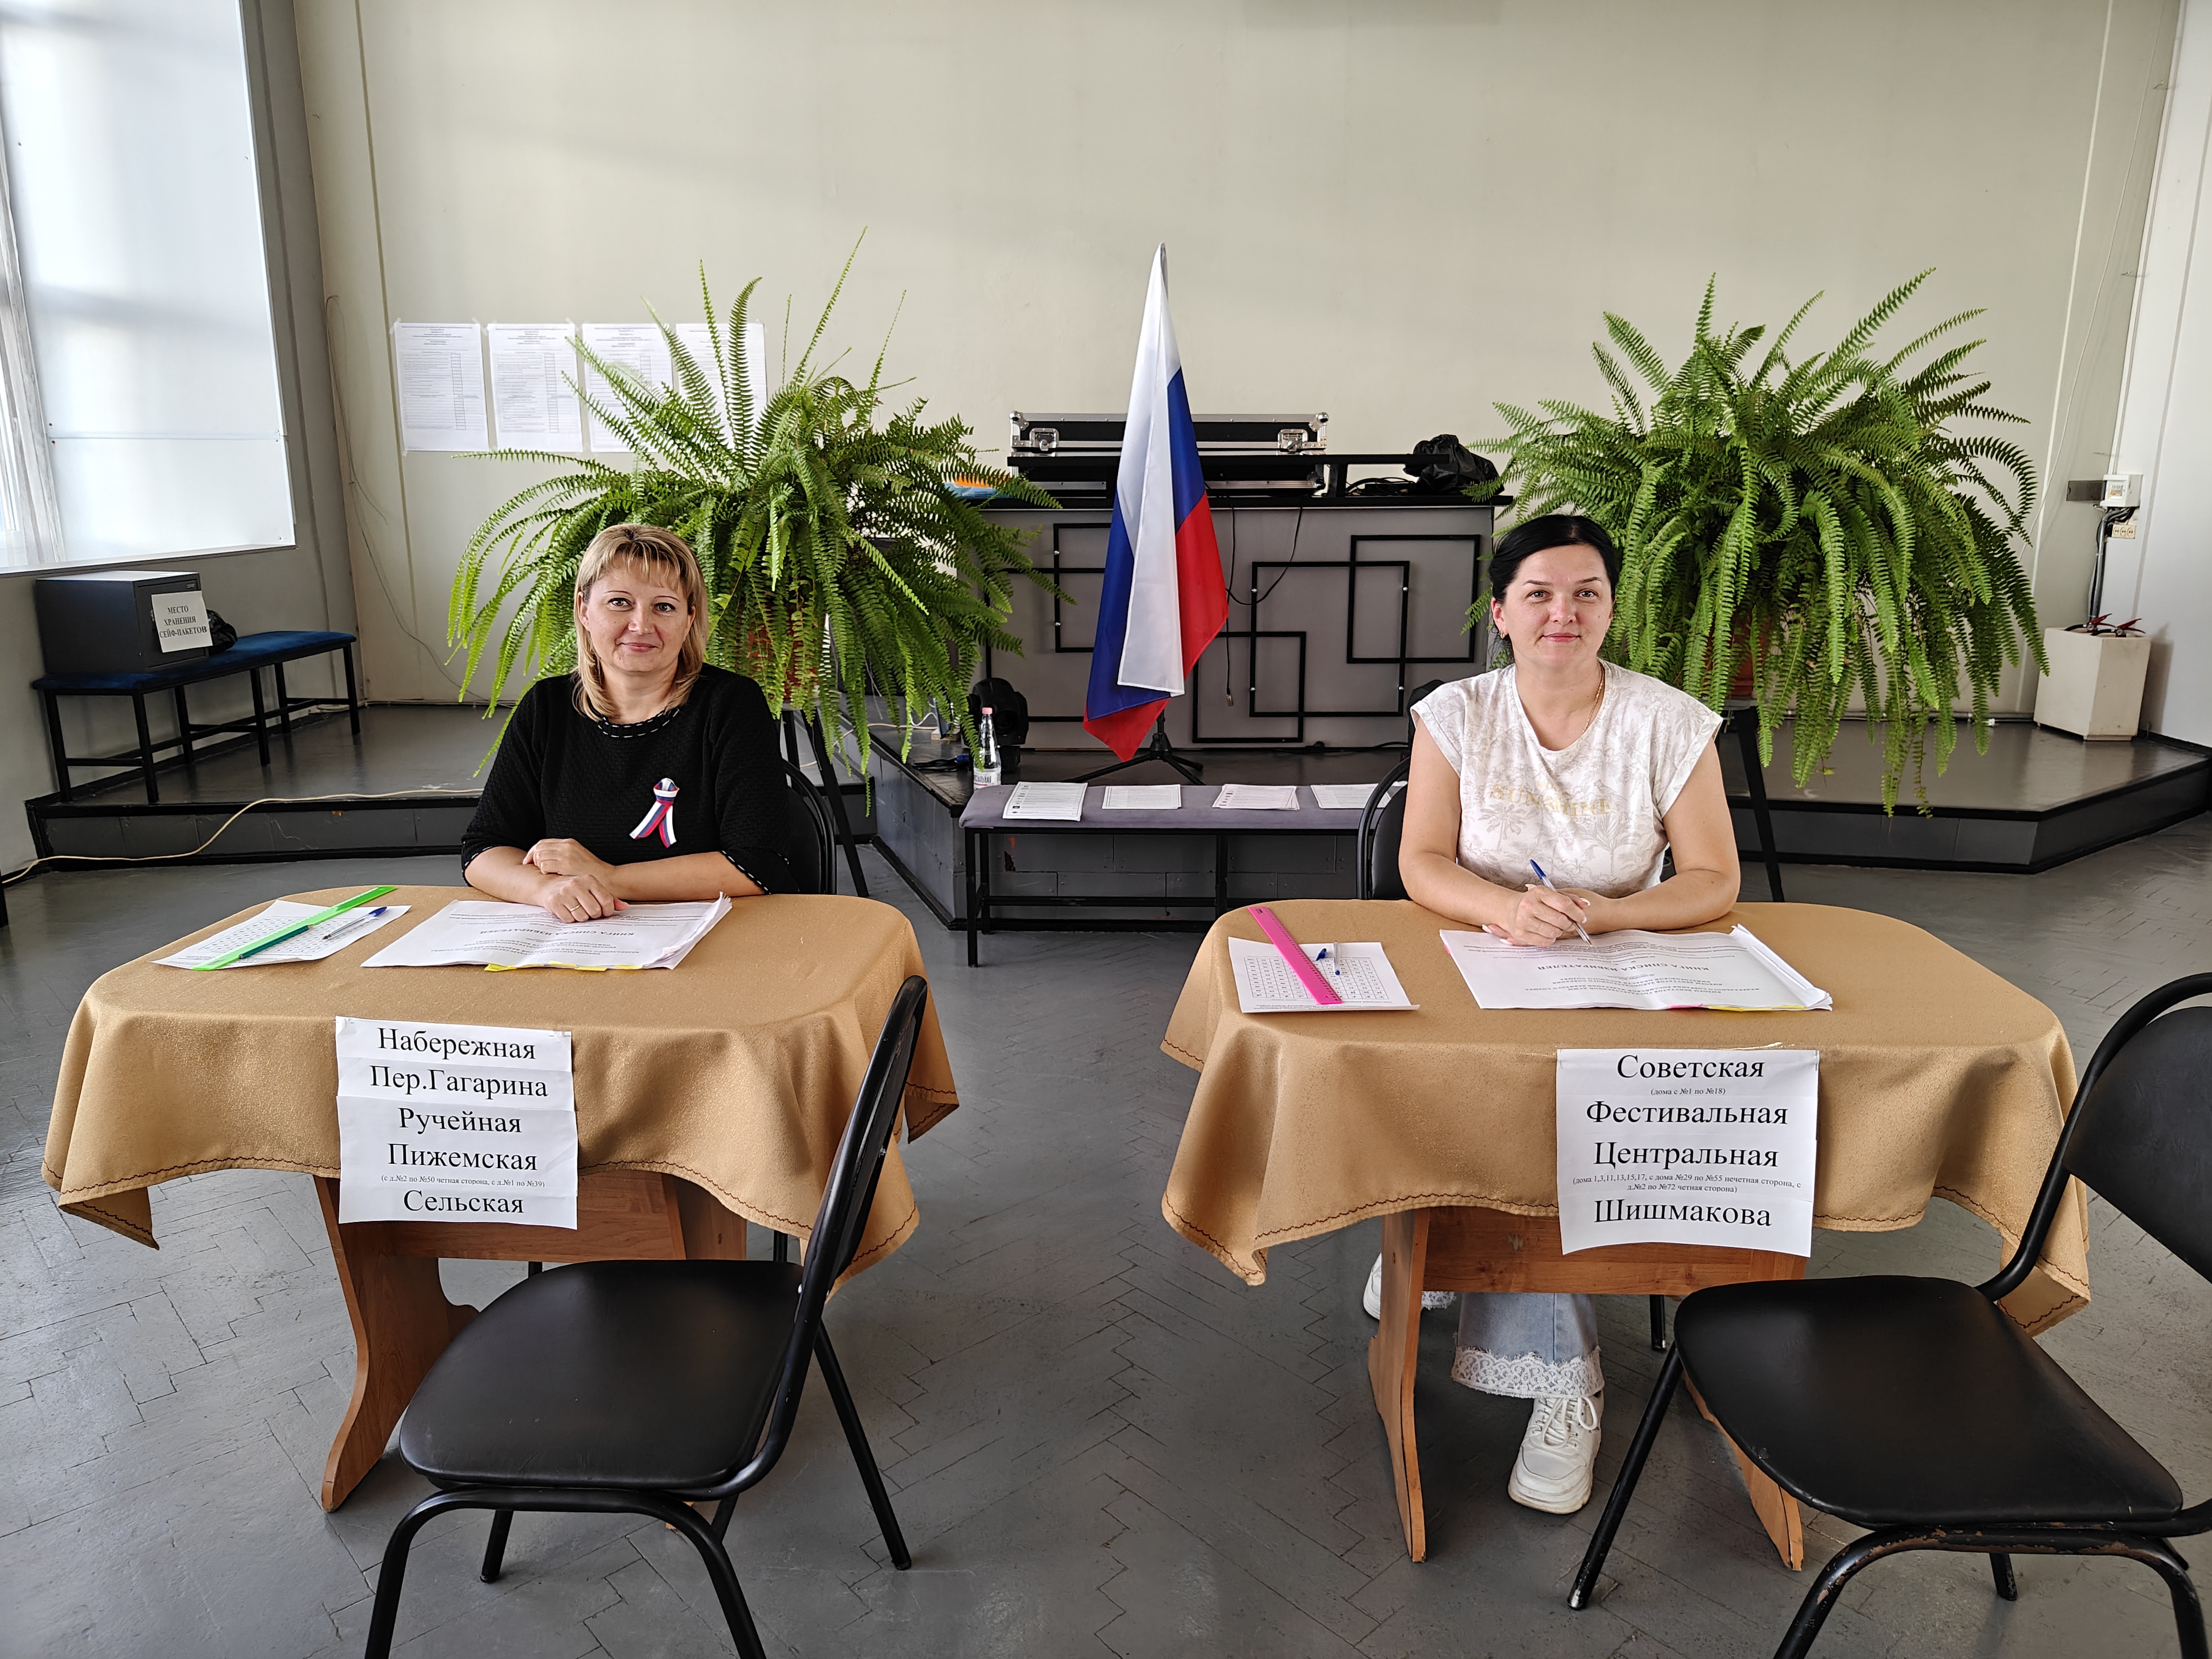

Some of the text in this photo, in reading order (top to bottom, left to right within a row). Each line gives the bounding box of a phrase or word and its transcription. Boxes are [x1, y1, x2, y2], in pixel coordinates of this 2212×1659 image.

[164, 616, 196, 626] ХРАНЕНИЯ
[167, 605, 188, 614] МЕСТО
[159, 626, 207, 638] СЕЙФ-ПАКЕТОВ
[377, 1027, 536, 1060] Набережная
[1617, 1055, 1765, 1079] Советская
[369, 1064, 549, 1099] Пер.Гагарина
[397, 1107, 522, 1134] Ручейная
[1586, 1100, 1789, 1124] Фестивальная
[387, 1143, 538, 1170] Пижемская
[1593, 1141, 1779, 1169] Центральная
[1572, 1176, 1591, 1185] (дома
[1675, 1174, 1692, 1182] №29
[1705, 1174, 1723, 1182] №55
[1724, 1176, 1759, 1184] нечетная
[1761, 1179, 1795, 1188] сторона,
[1658, 1183, 1676, 1191] №72
[1704, 1185, 1738, 1193] сторона)
[403, 1189, 524, 1213] Сельская
[1594, 1199, 1772, 1227] Шишмакова
